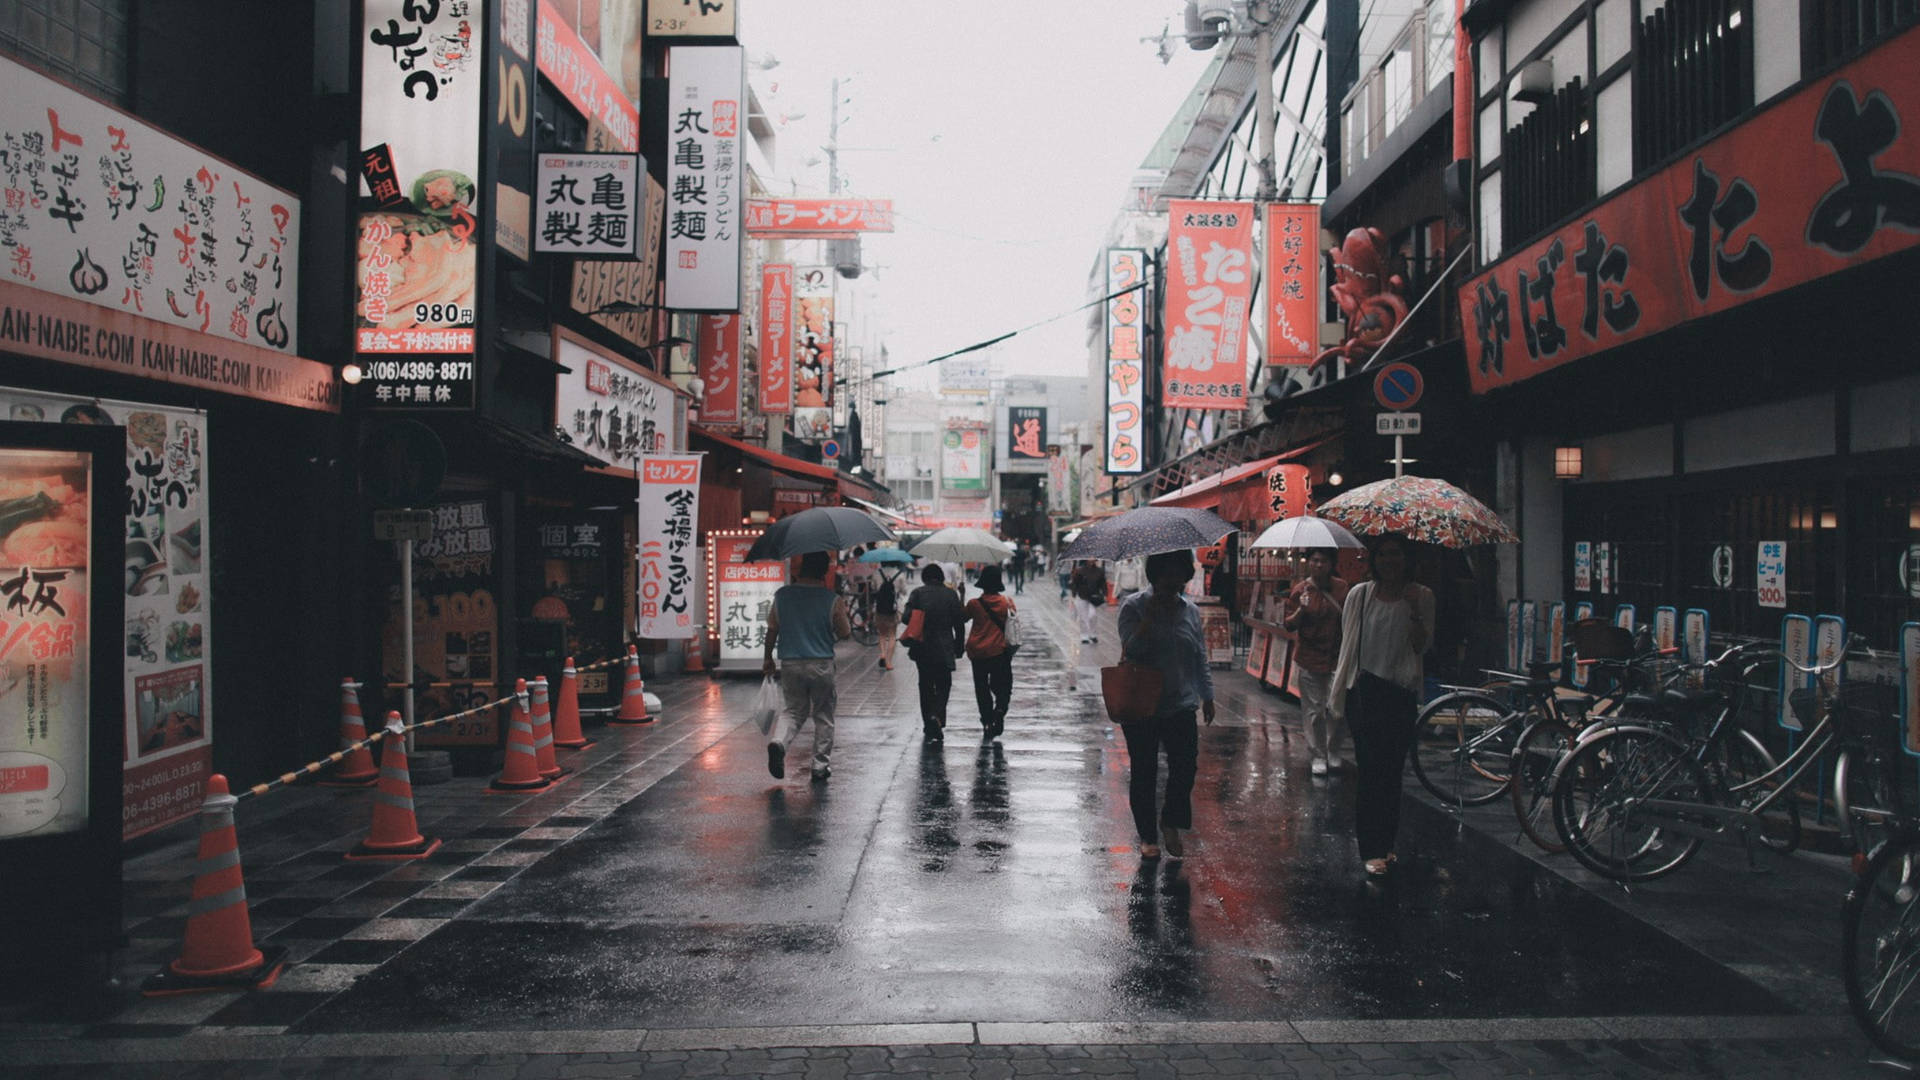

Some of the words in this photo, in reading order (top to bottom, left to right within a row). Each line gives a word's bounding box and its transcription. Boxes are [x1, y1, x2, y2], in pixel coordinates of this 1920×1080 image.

[366, 152, 399, 203] 元祖
[545, 172, 625, 210] 丸亀
[671, 107, 709, 241] 丸亀製麺
[542, 211, 628, 248] 製麺
[363, 219, 392, 323] かん焼き
[416, 303, 473, 325] 980円
[361, 332, 472, 350] 宴会ご予約受付中
[142, 338, 251, 390] KAN-NABE.COM
[1109, 254, 1142, 467] うる星やつら
[375, 384, 452, 402] 年中無休
[647, 464, 696, 480] セルフ
[538, 523, 600, 547] 個室
[662, 489, 695, 613] 釜揚げうどん
[1764, 544, 1780, 557] 中生
[725, 566, 780, 578] 店内54席
[1759, 562, 1784, 575] ビール
[122, 781, 202, 820] 06-4396-8871
